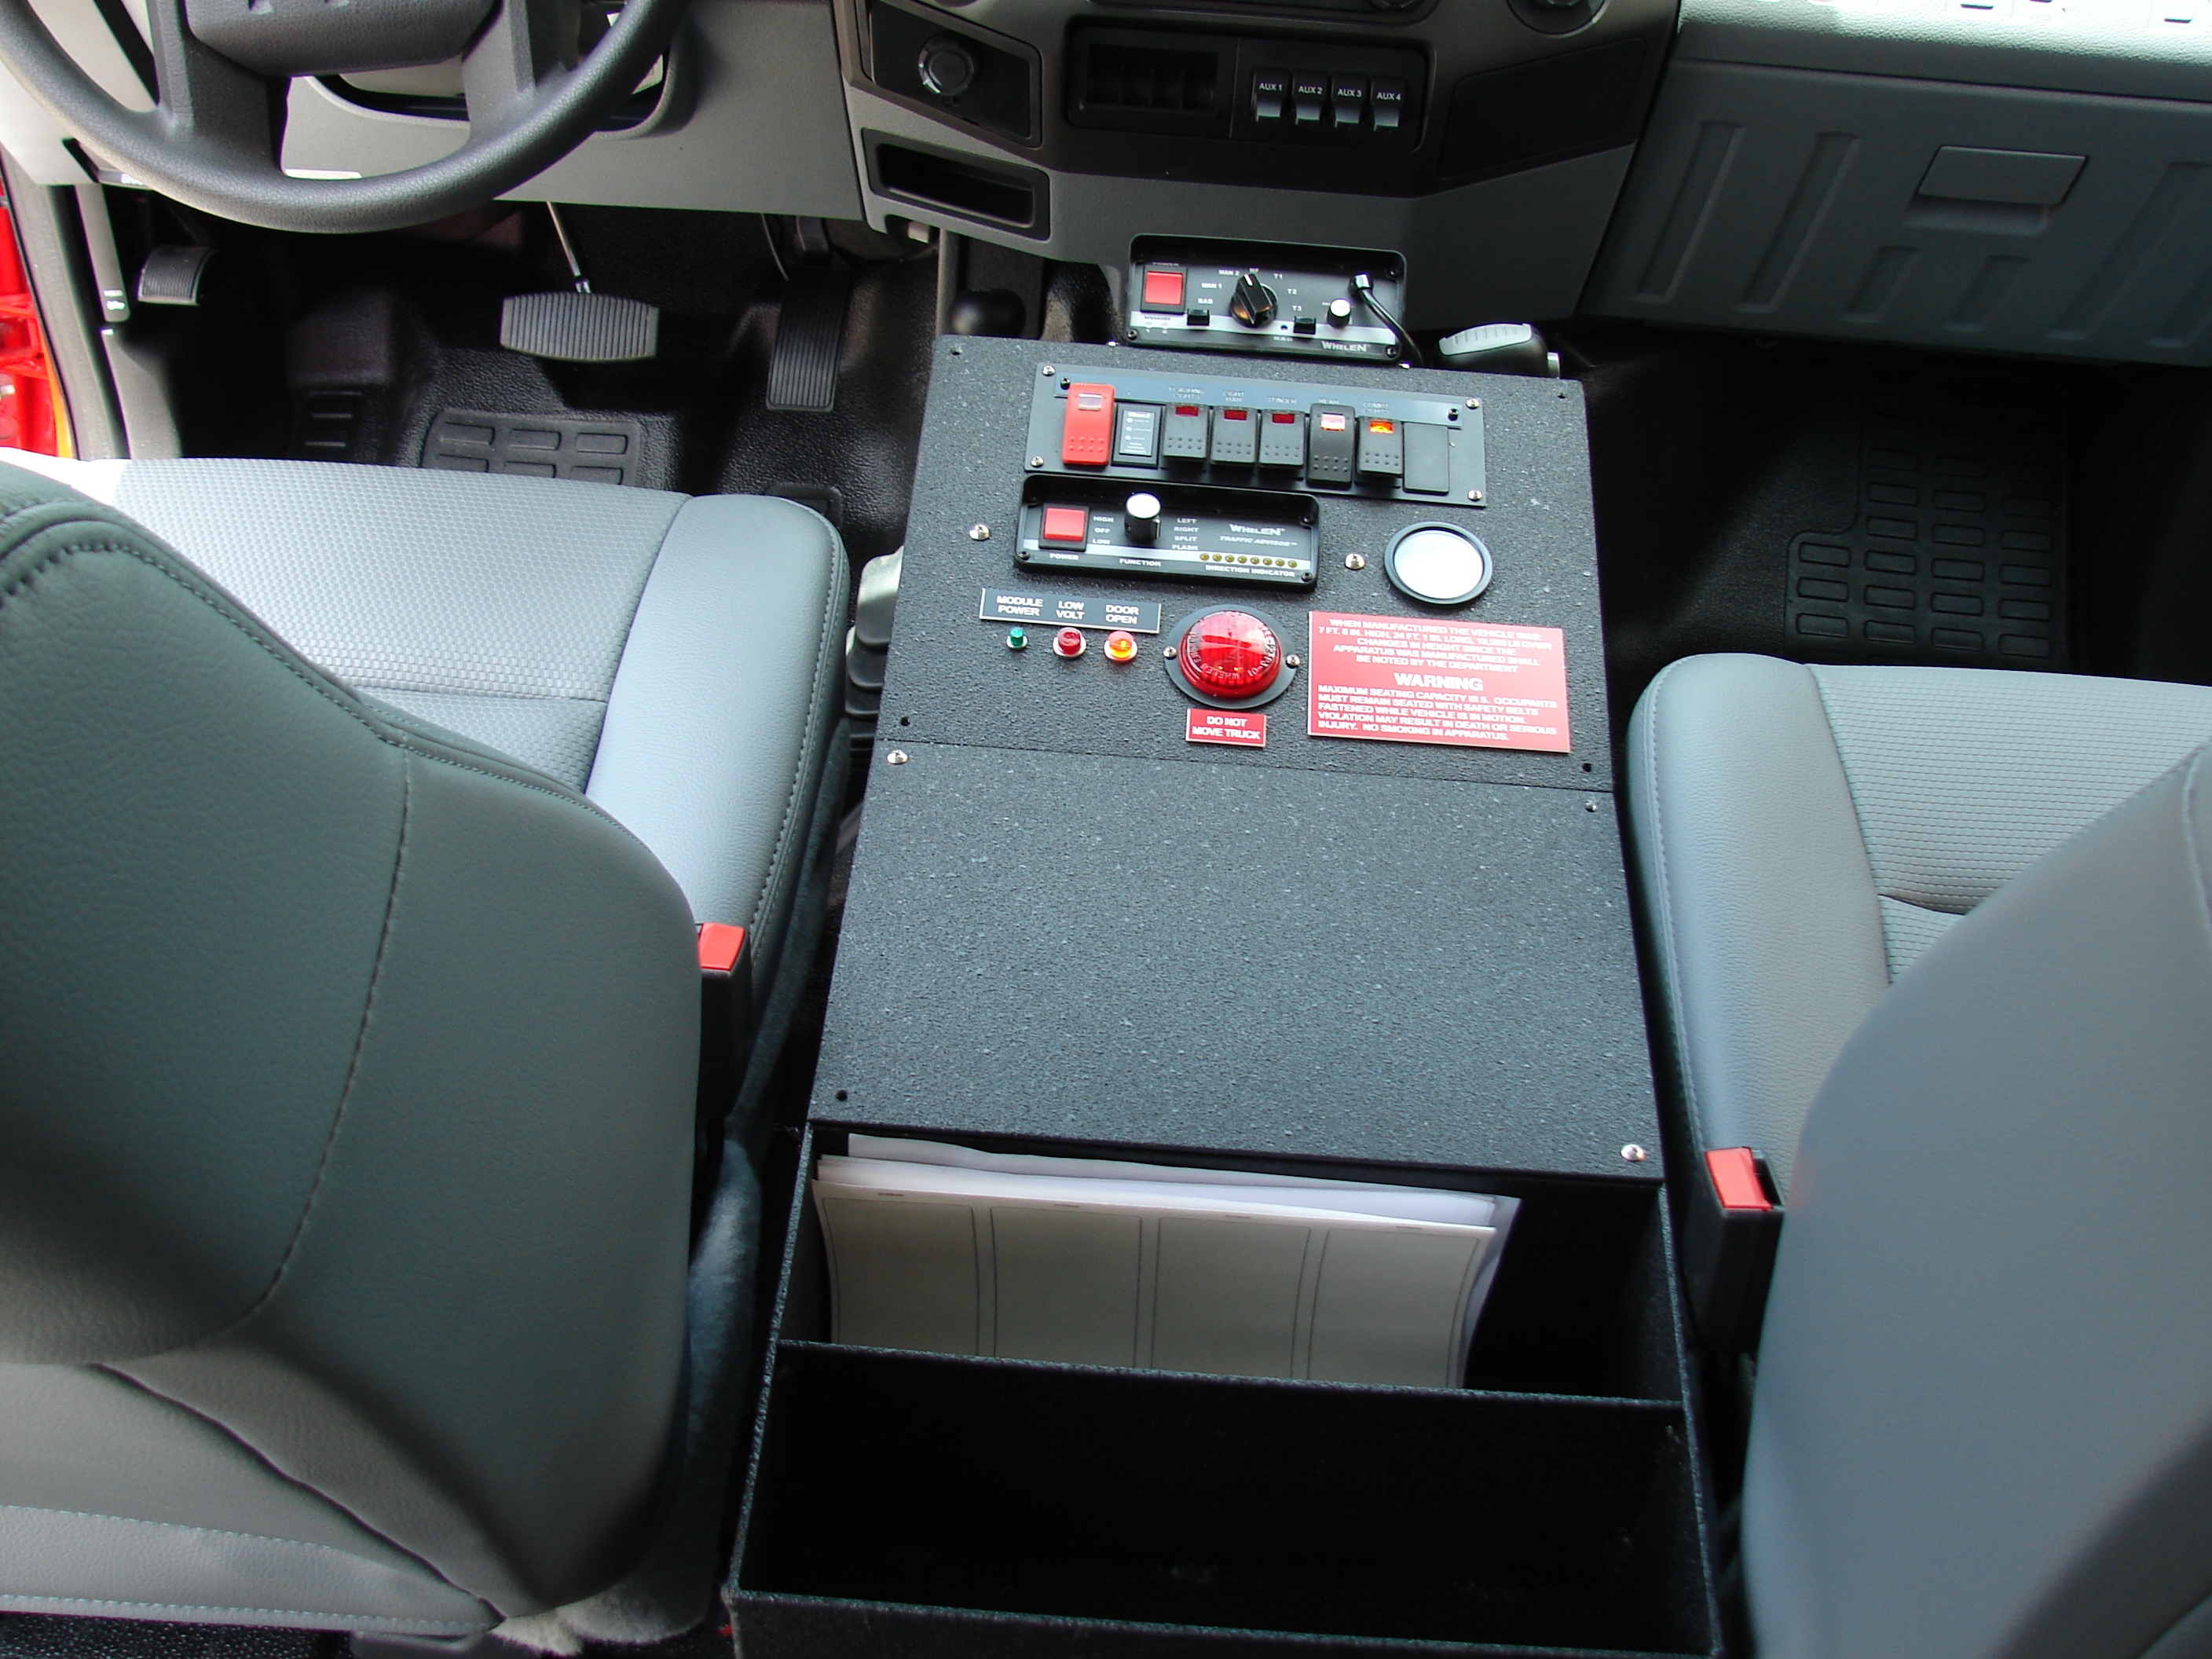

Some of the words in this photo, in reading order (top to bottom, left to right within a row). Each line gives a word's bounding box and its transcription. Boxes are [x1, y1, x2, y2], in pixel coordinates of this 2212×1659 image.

[1258, 82, 1276, 91] AUX
[1298, 86, 1317, 94] AUX
[1337, 89, 1355, 97] AUX
[1376, 92, 1394, 101] AUX
[1205, 565, 1250, 574] DIRECTION
[1251, 568, 1295, 577] INDICATOR
[997, 595, 1043, 606] MODULE
[1058, 600, 1084, 610] LOW
[998, 605, 1040, 617] POWER
[1056, 610, 1085, 620] VOLT
[1105, 604, 1139, 615] DOOR
[1105, 614, 1137, 624] OPEN
[1325, 627, 1340, 635] FT.
[1329, 619, 1361, 628] WHEN
[1363, 621, 1448, 634] MANUFACTURED
[1448, 626, 1470, 635] THE
[1470, 628, 1515, 639] VEHICLE
[1357, 637, 1408, 649] CHANGES
[1422, 642, 1462, 652] HEIGHT
[1462, 644, 1495, 655] SINCE
[1496, 647, 1517, 656] THE
[1333, 644, 1395, 657] APPARATUS
[1396, 649, 1420, 657] WAS
[1421, 650, 1506, 665] MANUFACTURED
[1507, 657, 1540, 666] SHALL
[1356, 654, 1372, 663] BE
[1372, 655, 1408, 665] NOTED
[1426, 659, 1447, 668] THE
[1448, 661, 1518, 673] DEPARTMENT
[1393, 672, 1484, 691] WARNING
[1318, 684, 1368, 695] MAXIMUM
[1369, 688, 1415, 698] SEATING
[1415, 691, 1467, 702] CAPACITY
[1493, 697, 1558, 708] OCCUPANTS
[1318, 694, 1348, 702] MUST
[1350, 695, 1391, 705] REMAIN
[1392, 698, 1434, 709] SEATED
[1434, 701, 1463, 711] WITH
[1464, 704, 1506, 713] SAFETY
[1506, 707, 1540, 716] BELTS
[1318, 702, 1374, 713] FASTENED
[1375, 706, 1408, 716] WHILE
[1409, 709, 1456, 719] VEHICLE
[1469, 712, 1481, 721] IN
[1207, 716, 1224, 725] DO
[1225, 717, 1247, 727] NOT
[1317, 711, 1375, 722] VIOLATION
[1375, 715, 1399, 724] MAY
[1400, 717, 1441, 727] RESULT
[1442, 720, 1453, 728] IN
[1455, 720, 1490, 731] DEATH
[1509, 724, 1557, 735] SERIOUS
[1192, 726, 1223, 737] MOVE
[1224, 730, 1261, 740] TRUCK
[1318, 720, 1359, 731] INJURY.
[1362, 723, 1379, 731] NO
[1380, 725, 1430, 736] SMOKING
[1444, 729, 1510, 740] APPARATUS.
